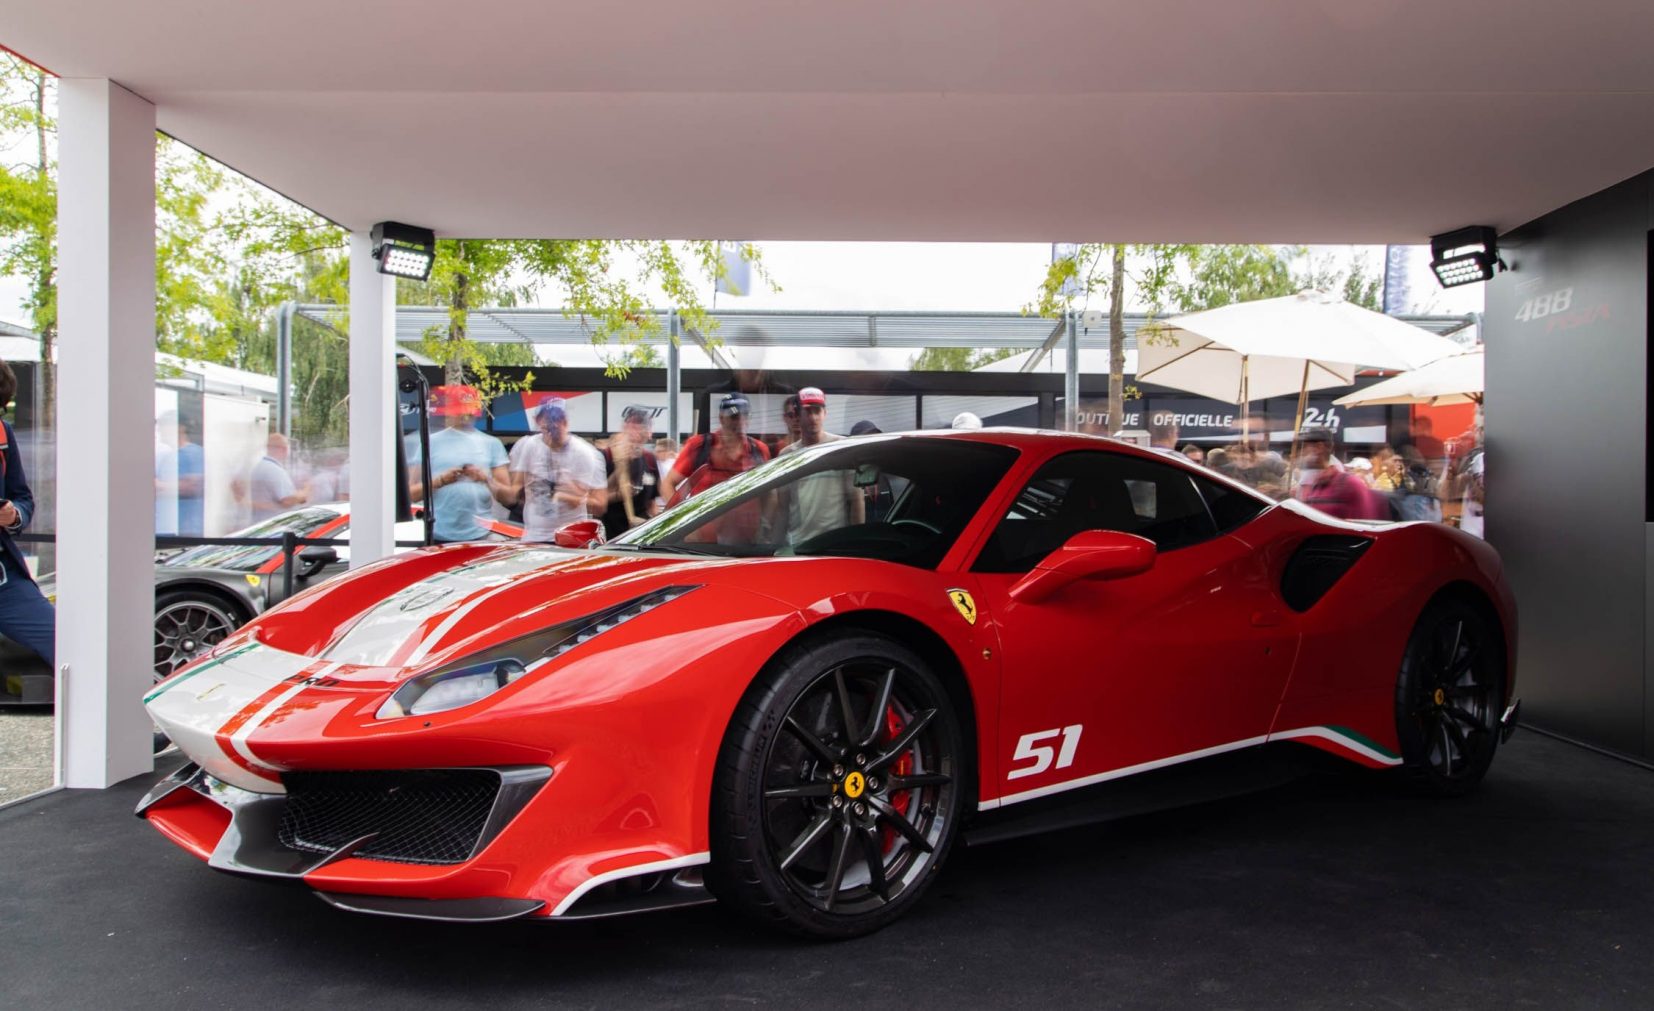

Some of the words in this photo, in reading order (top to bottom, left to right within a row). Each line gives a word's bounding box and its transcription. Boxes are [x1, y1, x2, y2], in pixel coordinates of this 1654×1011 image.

[1515, 287, 1574, 322] 488
[1153, 413, 1234, 427] OFFICIELLE
[1302, 406, 1341, 427] 24h
[1007, 723, 1084, 781] 51
